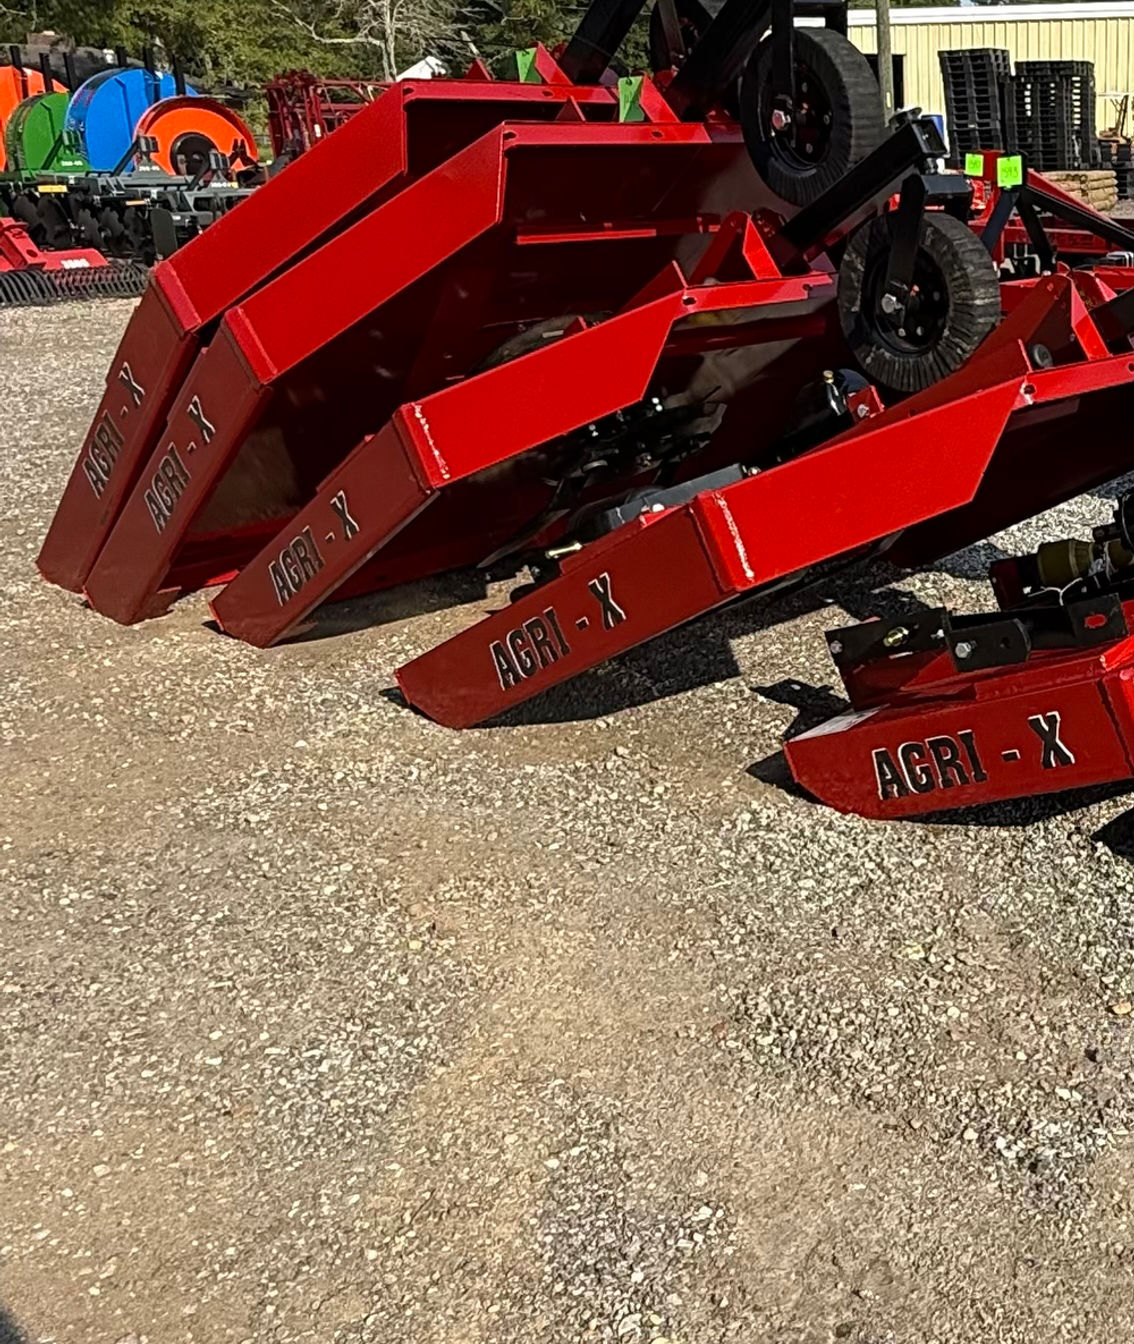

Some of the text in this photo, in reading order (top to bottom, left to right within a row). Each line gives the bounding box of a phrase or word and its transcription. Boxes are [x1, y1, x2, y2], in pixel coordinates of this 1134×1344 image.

[82, 409, 125, 499] AGRI
[118, 361, 146, 406] X
[144, 441, 191, 534] AGRI
[187, 395, 216, 444] X
[268, 525, 326, 607] AGRI
[330, 490, 360, 542] X
[489, 606, 571, 692] AGRI
[588, 572, 627, 633] X
[871, 729, 988, 801] AGRI
[1027, 711, 1076, 770] X
